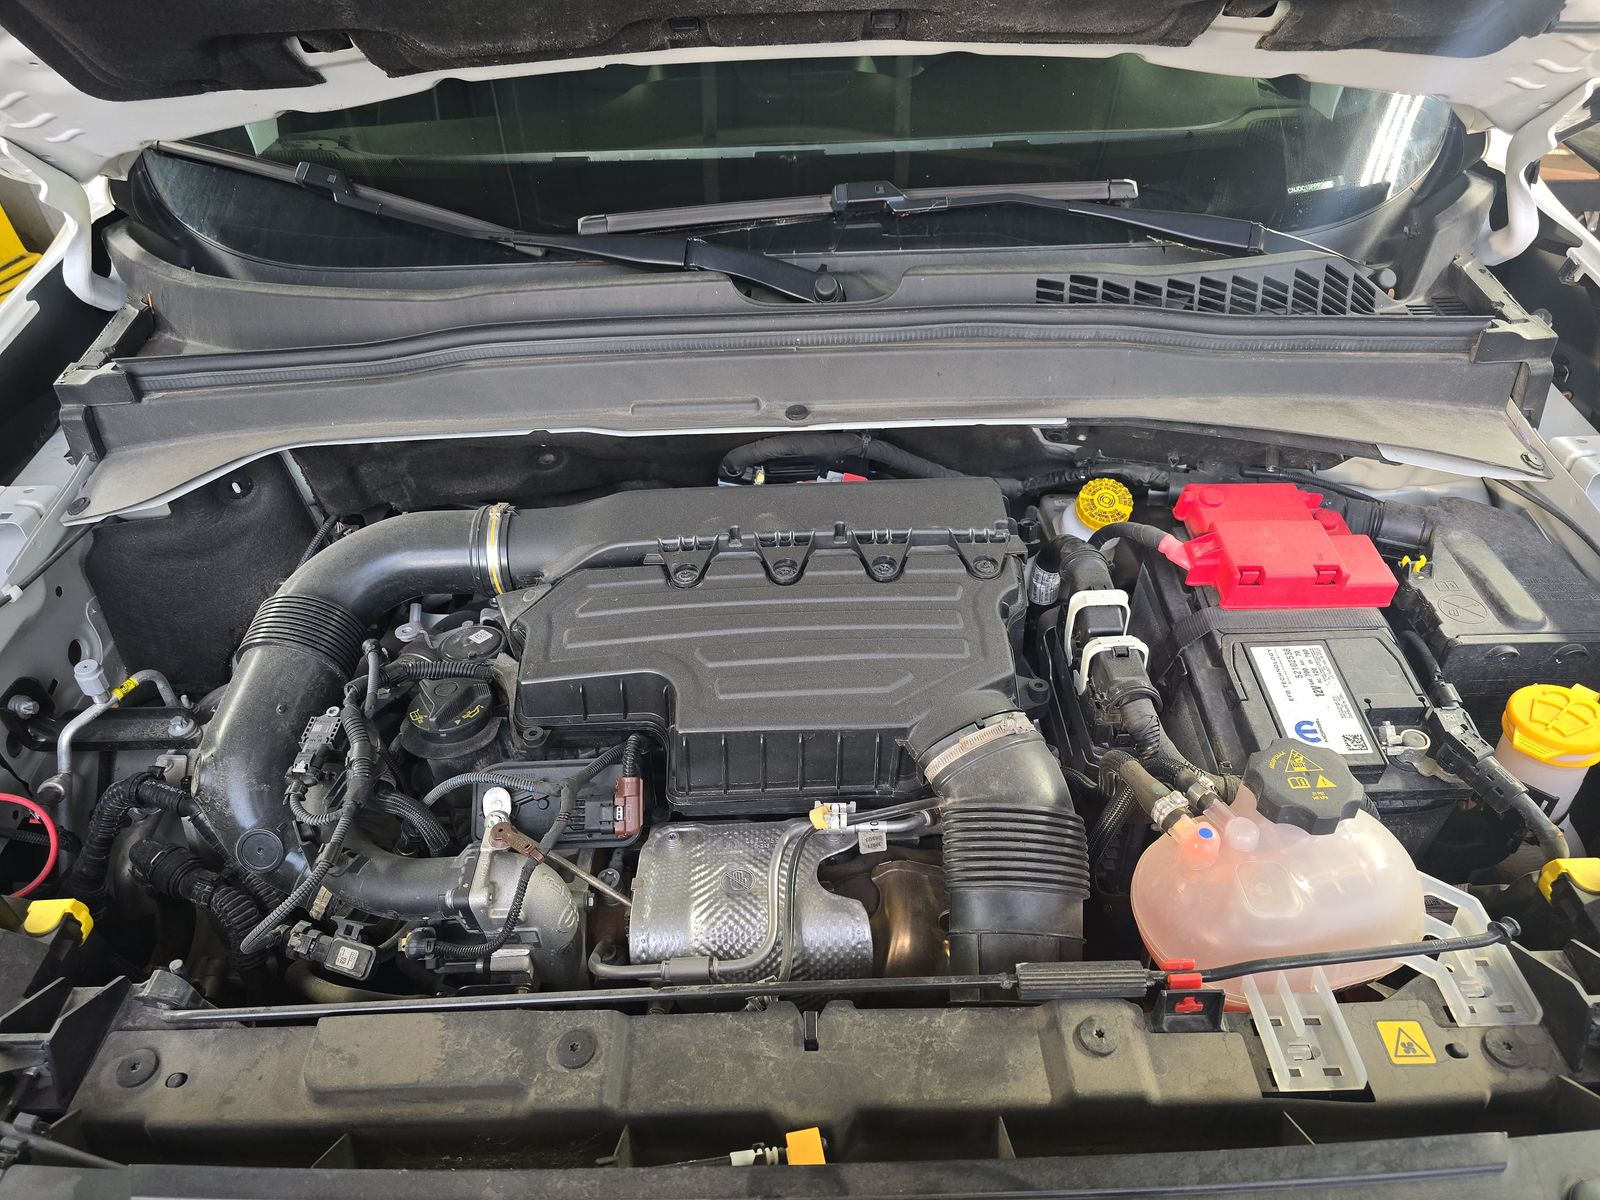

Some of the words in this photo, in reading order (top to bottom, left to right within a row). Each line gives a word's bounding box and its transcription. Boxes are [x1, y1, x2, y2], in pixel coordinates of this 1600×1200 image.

[1266, 648, 1288, 688] TECHNOLOGY
[1282, 648, 1304, 678] 52102538
[1285, 690, 1294, 702] EFB
[1310, 685, 1325, 697] 12V
